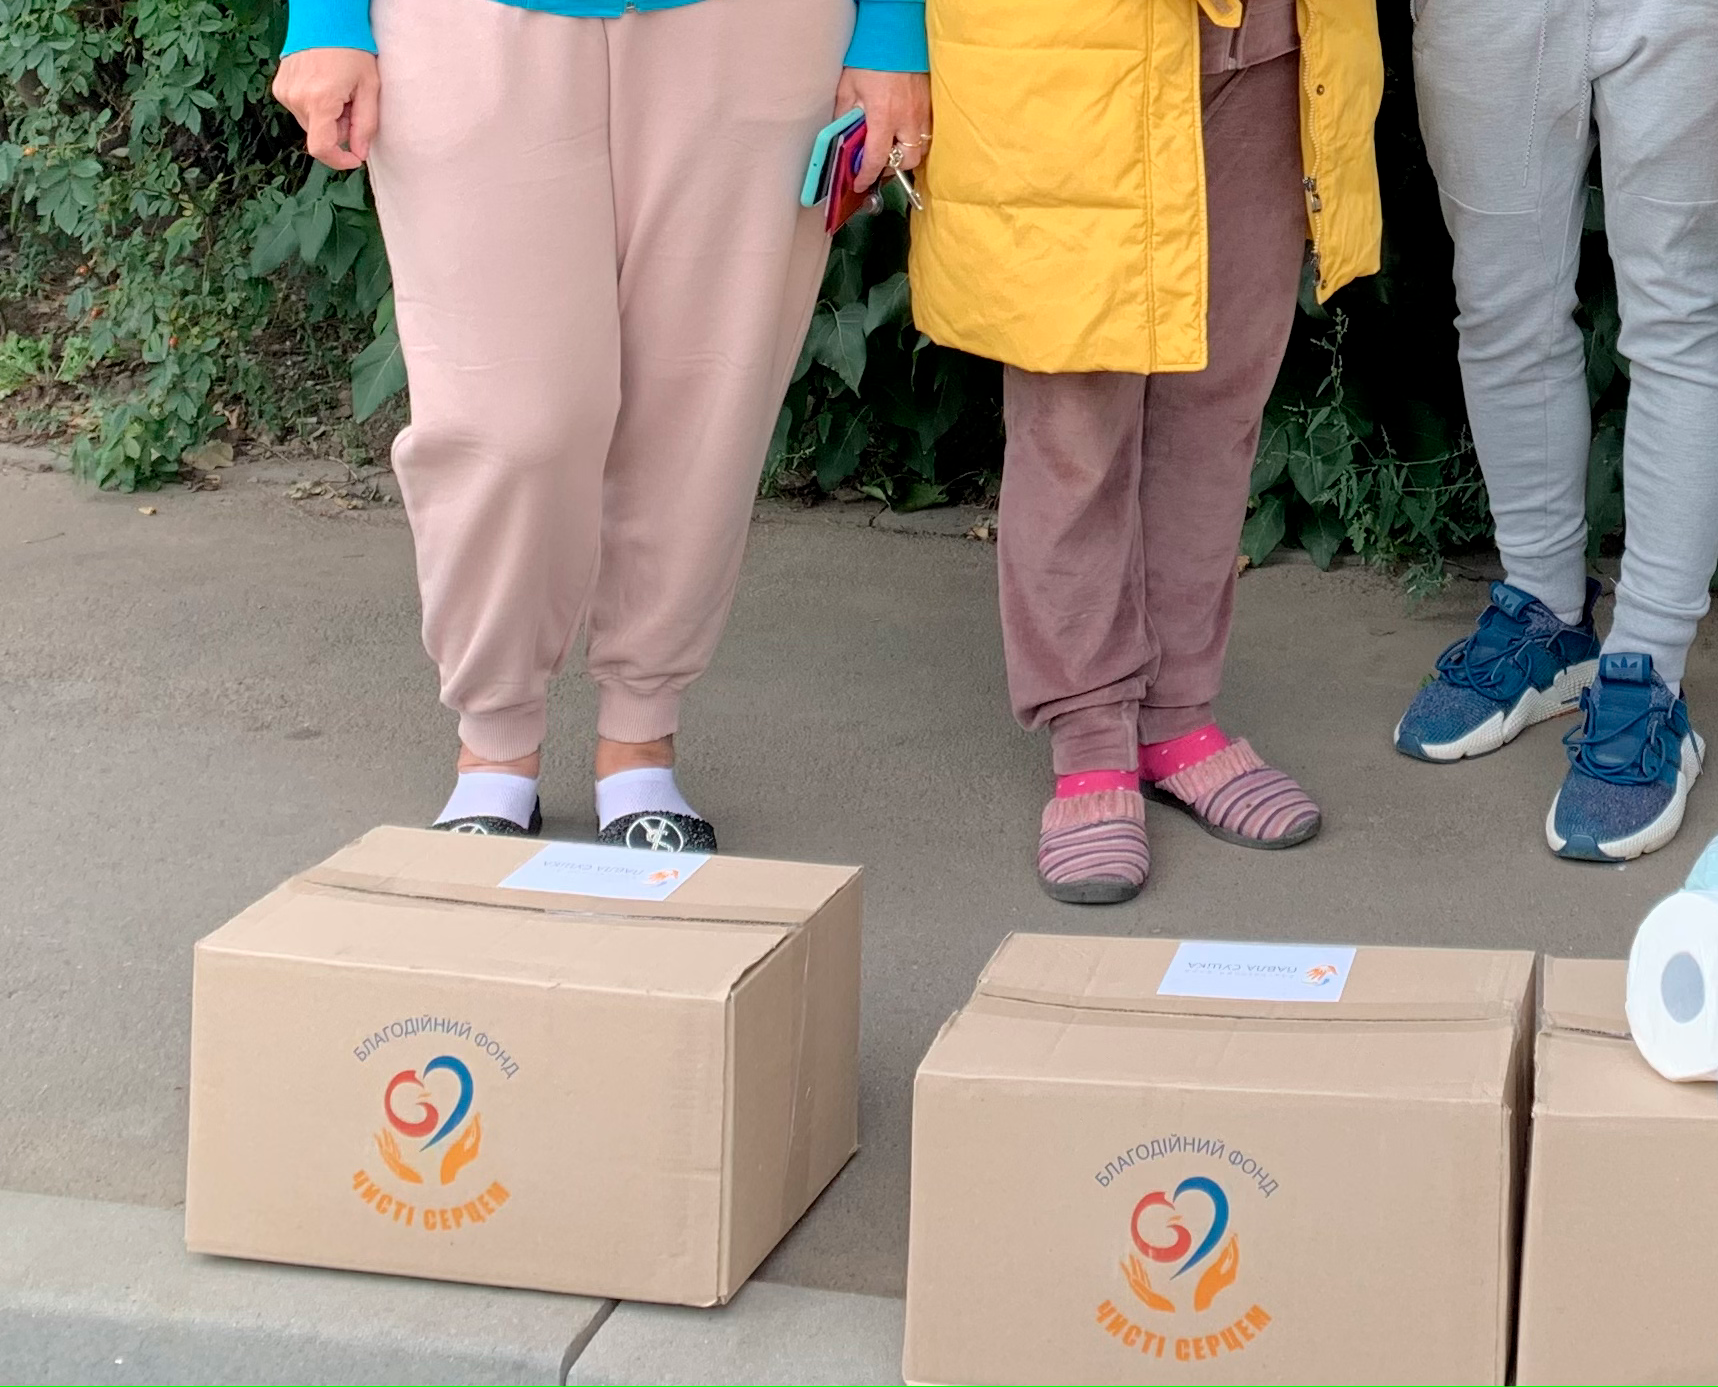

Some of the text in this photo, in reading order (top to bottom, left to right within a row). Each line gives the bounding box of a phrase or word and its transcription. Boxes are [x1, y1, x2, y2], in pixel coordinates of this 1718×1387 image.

[352, 1014, 520, 1080] БЛАГОДІЙНИЙ ФОНД
[1094, 1133, 1280, 1199] БЛАГОДІЙНИЙ ФОНД
[351, 1169, 512, 1232] ЧИСТІ СЕРЦЕМ
[1094, 1299, 1273, 1363] ЧИСТІ СЕРЦЕМ
